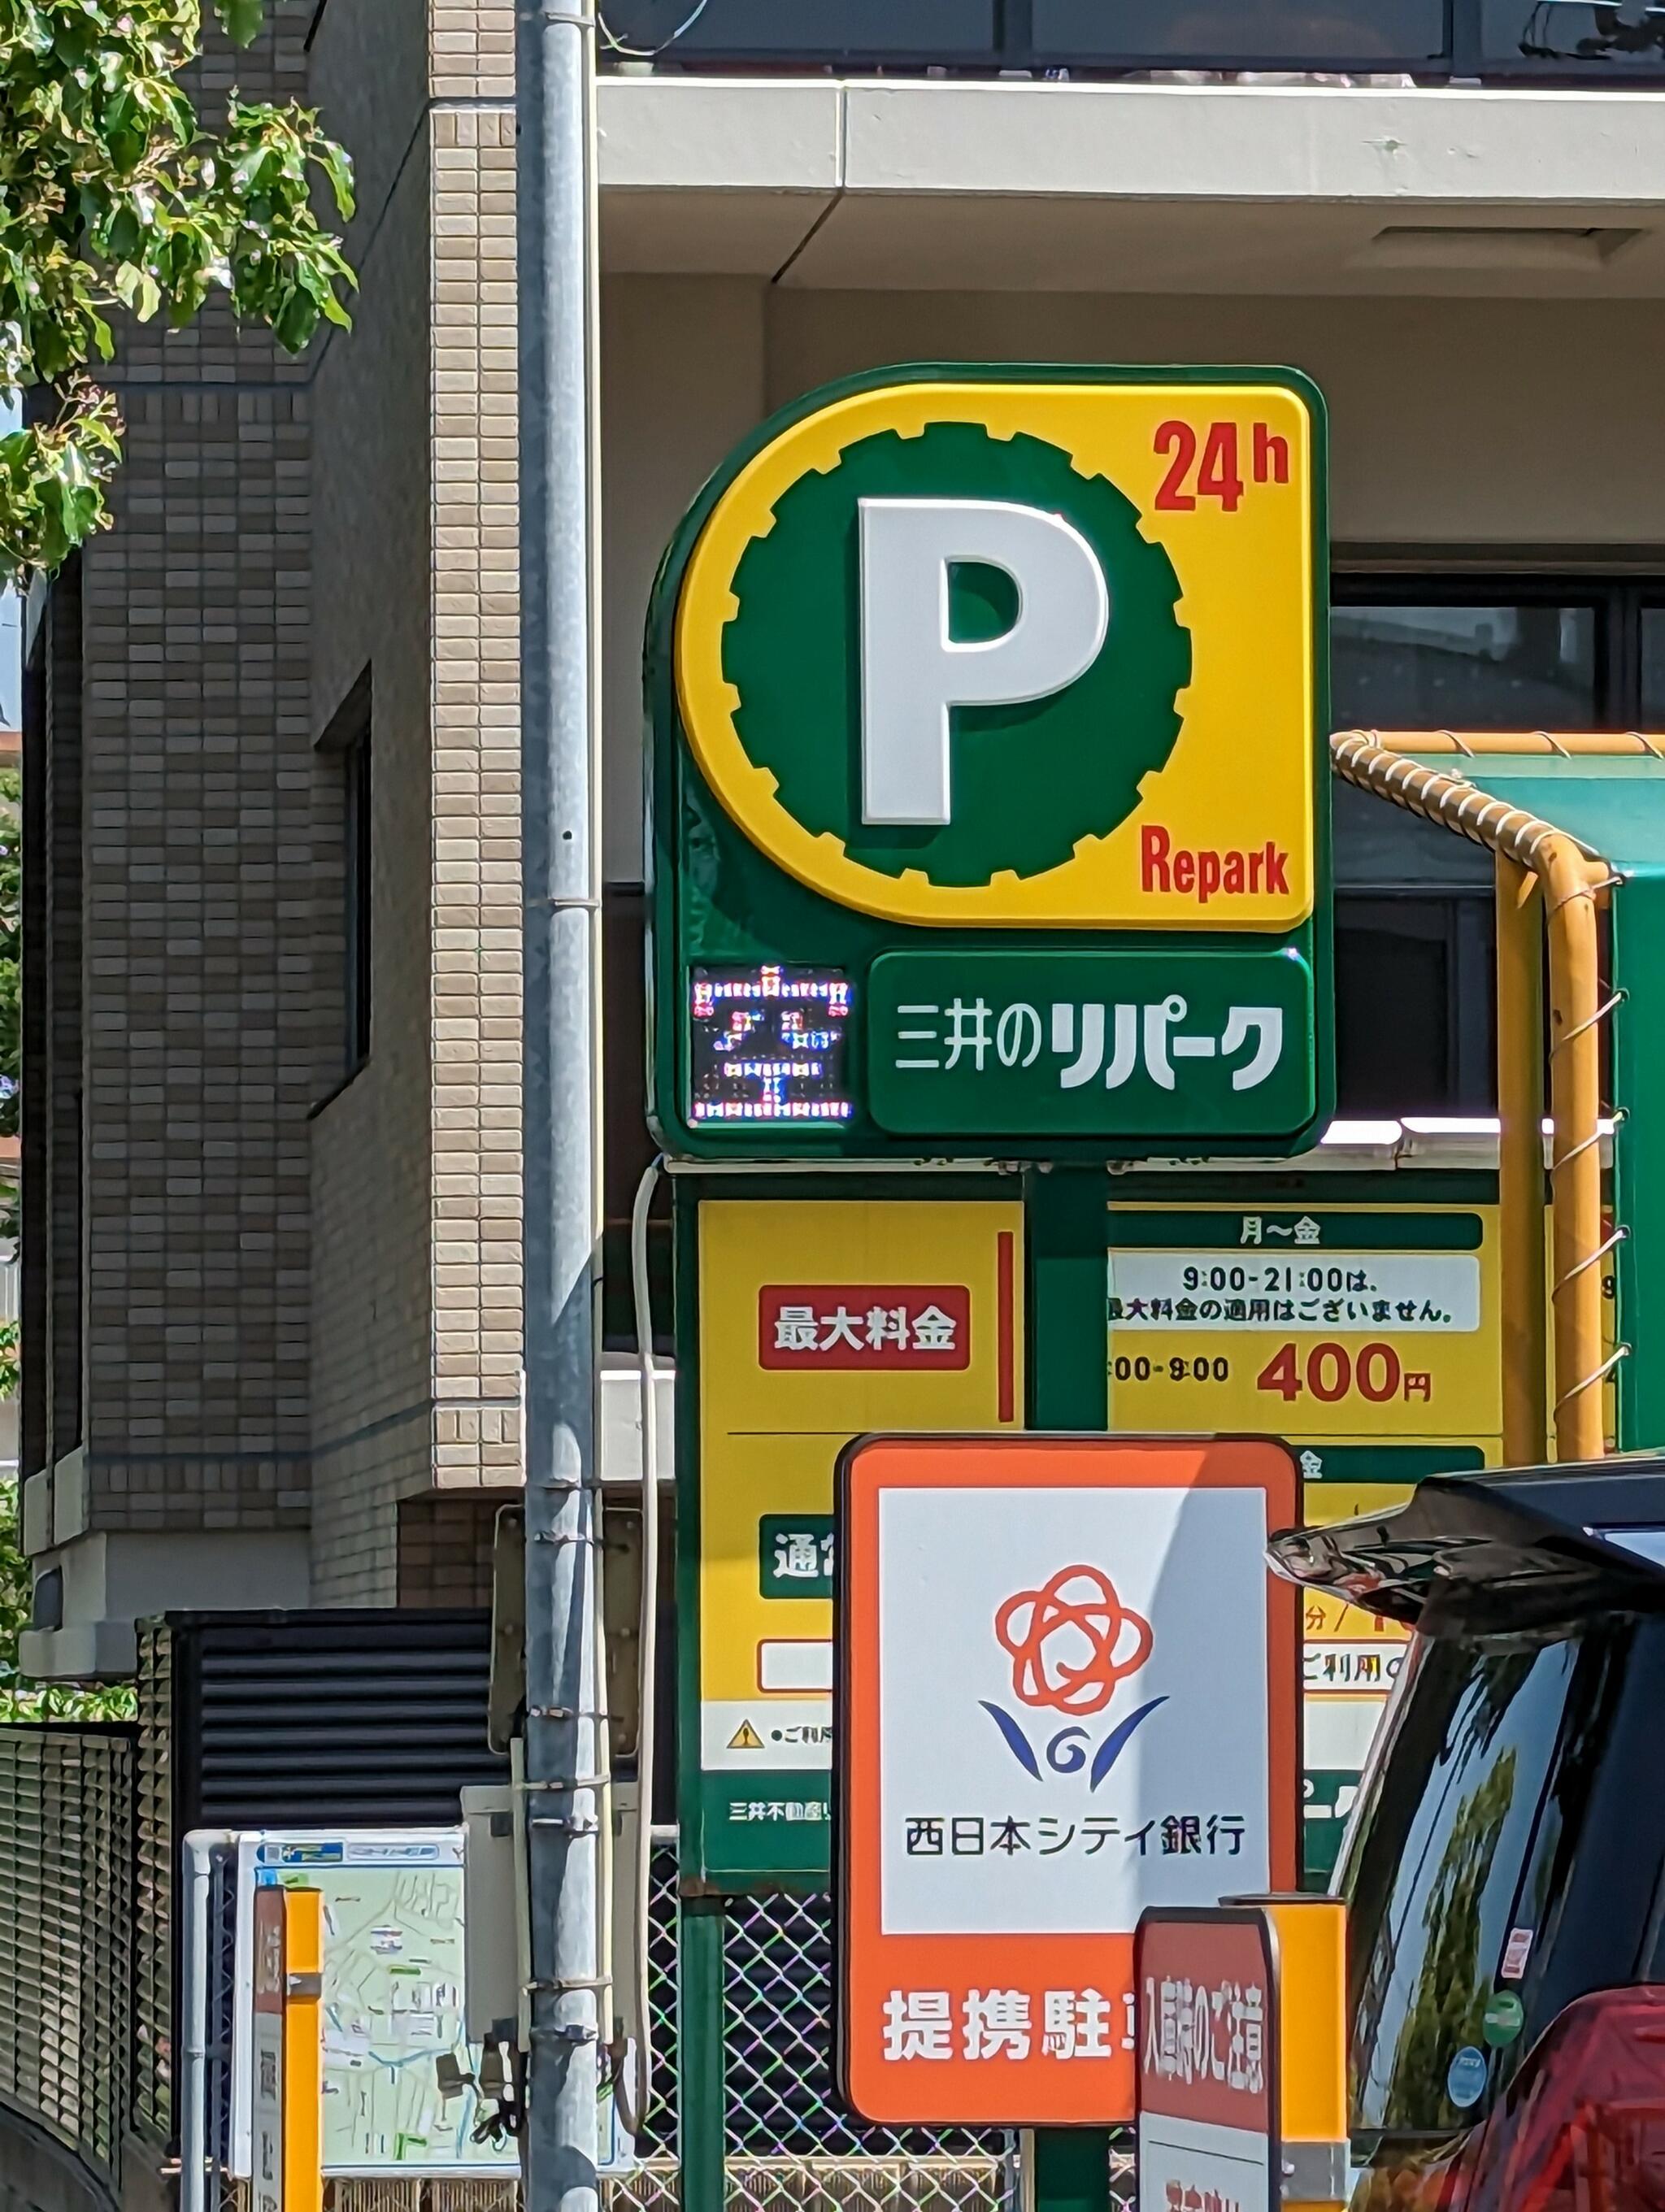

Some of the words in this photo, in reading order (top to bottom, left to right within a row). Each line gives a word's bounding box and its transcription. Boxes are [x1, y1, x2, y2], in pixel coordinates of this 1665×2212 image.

[859, 498, 1108, 824] P
[1141, 824, 1289, 904] Repark
[895, 993, 1284, 1091] 三井のリパーク
[773, 1306, 958, 1353] 最大料金
[1256, 1342, 1432, 1403] 400円
[1300, 1450, 1323, 1480] 金
[906, 1815, 1245, 1857] 西日本シティ銀行
[882, 1988, 1135, 2062] 提携駐
